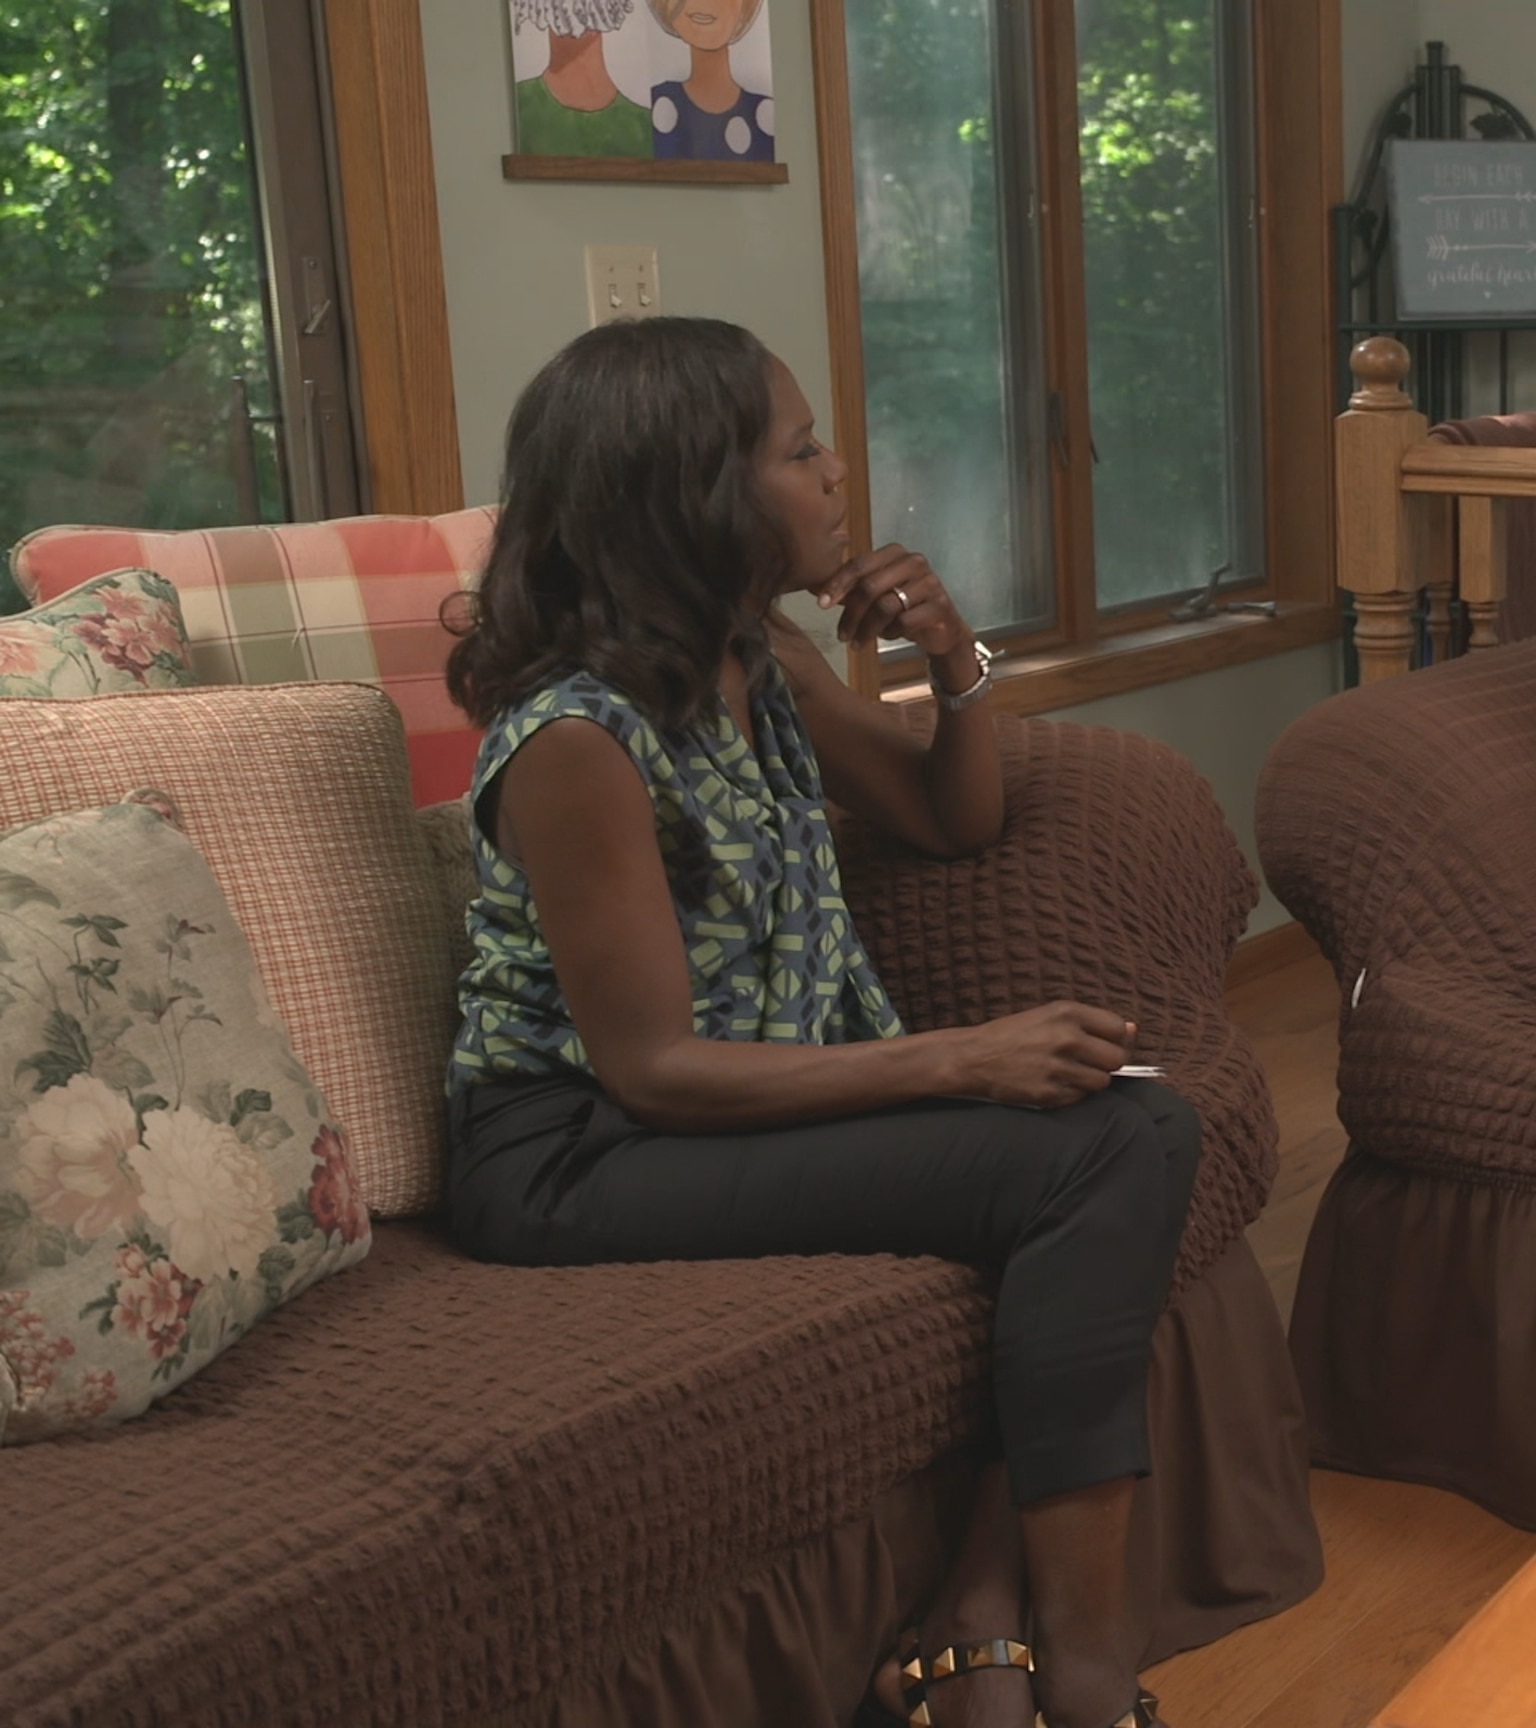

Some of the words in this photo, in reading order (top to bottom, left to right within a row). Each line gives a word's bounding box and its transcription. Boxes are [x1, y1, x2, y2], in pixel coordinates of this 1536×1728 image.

[1433, 163, 1478, 187] BEGIN
[1487, 163, 1524, 186] EACH
[1434, 208, 1460, 231] DAY
[1472, 207, 1510, 231] WITH
[1519, 207, 1529, 231] A
[1427, 261, 1492, 290] grateful
